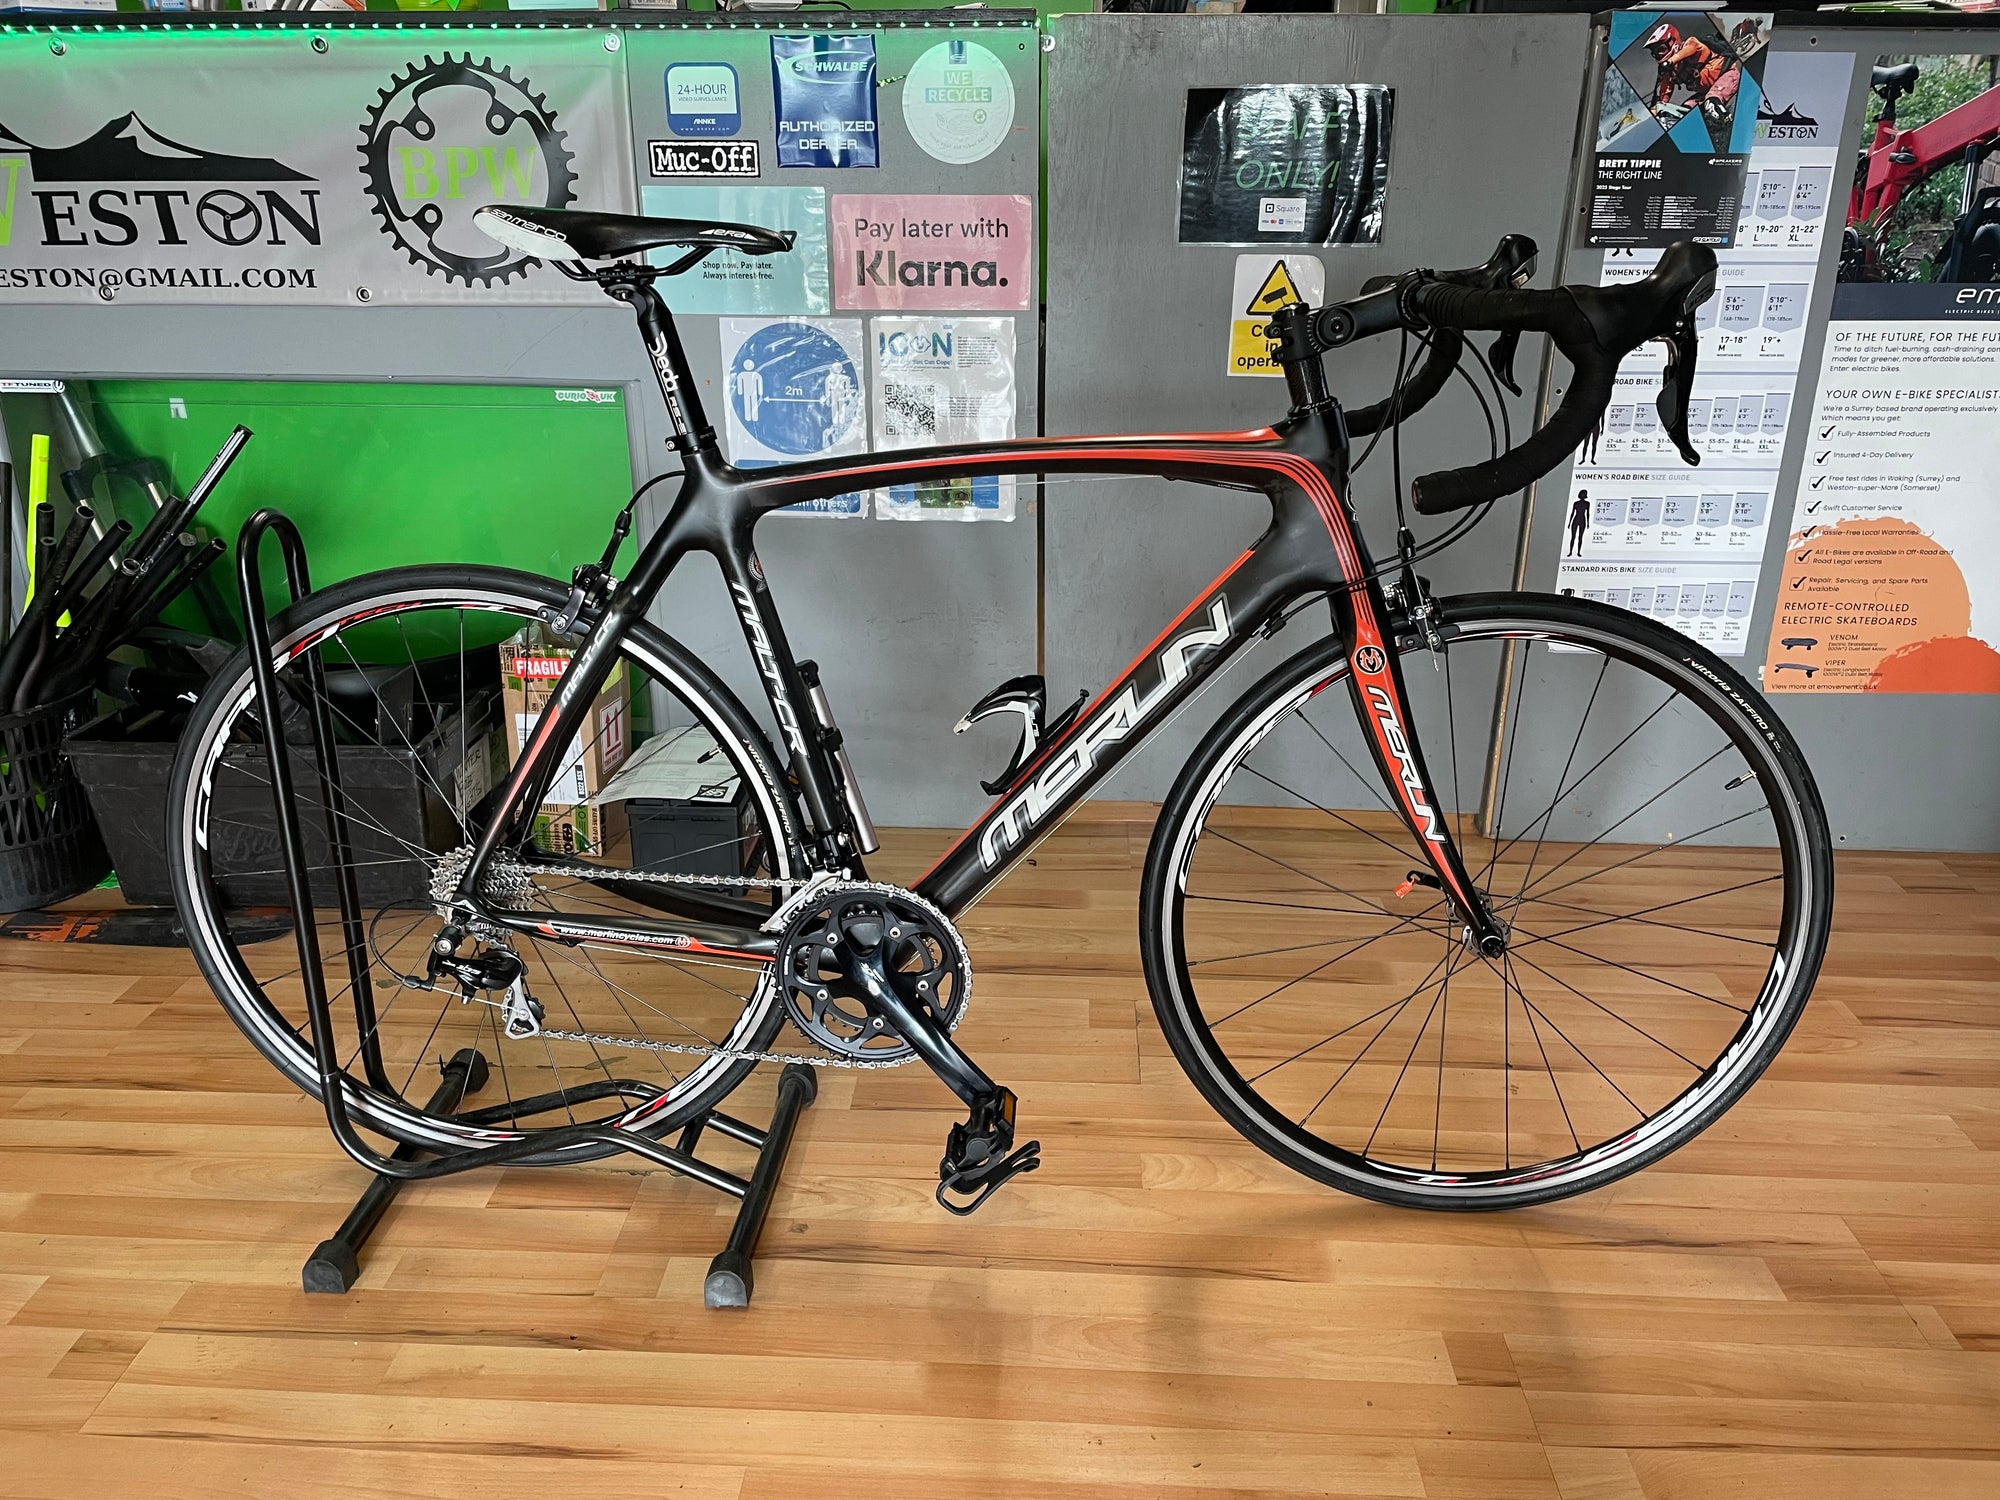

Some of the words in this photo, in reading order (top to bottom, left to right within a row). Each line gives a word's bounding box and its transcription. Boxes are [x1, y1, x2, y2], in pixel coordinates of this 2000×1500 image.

[794, 61, 868, 72] SCHWALBE
[946, 72, 971, 85] WE
[677, 84, 727, 94] 24-HOUR
[927, 88, 990, 102] RECYCLE
[780, 120, 875, 132] AUTHORIZED
[799, 138, 858, 150] DEAER
[655, 147, 756, 173] Muc-Off
[1598, 159, 1628, 168] BRETT
[1630, 159, 1662, 168] TIPPIE
[395, 145, 537, 201] BPW
[1235, 160, 1341, 190] ONLY!
[1598, 170, 1614, 180] THE
[1615, 170, 1642, 180] RIGHT
[1644, 170, 1663, 180] LINE
[1276, 205, 1301, 213] Square
[854, 218, 895, 242] Pay
[903, 217, 952, 238] later
[959, 217, 1009, 238] with
[1790, 225, 1818, 233] 21-22"
[1788, 234, 1800, 242] XL
[702, 262, 721, 270] Shop
[740, 262, 755, 270] Pay
[856, 250, 1009, 287] Klarna.
[702, 271, 728, 281] Always
[1604, 268, 1647, 276] WOMEN'S
[1722, 268, 1745, 276] GUIDE
[1835, 332, 1851, 342] OF
[1856, 332, 1877, 342] THE
[1881, 332, 1926, 342] FUTURE,
[1930, 332, 1952, 342] FOR
[1957, 332, 1978, 342] THE
[1834, 346, 1852, 354] Time
[1864, 346, 1883, 354] ditch
[1831, 356, 1857, 364] modes
[1859, 356, 1869, 364] for
[1902, 356, 1921, 364] more
[1922, 356, 1960, 364] affordable
[1614, 378, 1634, 386] ROAD
[1636, 378, 1653, 386] BIKE
[785, 385, 803, 396] 2m
[1826, 390, 1857, 399] YOUR
[1861, 390, 1891, 399] OWN
[1895, 390, 1932, 399] E-BIKE
[1823, 405, 1842, 413] We're
[1851, 405, 1874, 413] Surrey
[1876, 405, 1899, 413] based
[1901, 405, 1923, 413] brand
[1924, 405, 1958, 413] operating
[1960, 405, 1998, 413] exclusively
[1837, 430, 1897, 438] Fully-Assembled
[1898, 430, 1931, 438] Products
[1829, 475, 1844, 483] Free
[1846, 475, 1859, 483] test
[1860, 475, 1878, 483] rides
[1887, 475, 1914, 483] Woking
[1915, 475, 1944, 483] (Surrey)
[1946, 475, 1960, 483] and
[1827, 484, 1898, 492] Weston-super-Mare
[1900, 484, 1940, 492] (Somerset)
[1872, 577, 1886, 585] and
[1888, 577, 1908, 585] Spare
[1911, 577, 1928, 585] Parts
[1784, 603, 1910, 612] REMOTE-CONTROLLED
[1782, 616, 1832, 626] ELECTRIC
[1837, 616, 1917, 626] SKATEBOARDS
[560, 611, 614, 707] MALT-CR
[731, 580, 810, 759] MALT-CR
[1729, 691, 1769, 730] ZAFFIRO
[980, 597, 1232, 870] MERLIN
[1366, 684, 1448, 843] MERLIN
[770, 787, 792, 834] ZAFFIRO
[560, 926, 674, 945] www.merlincycles.com
